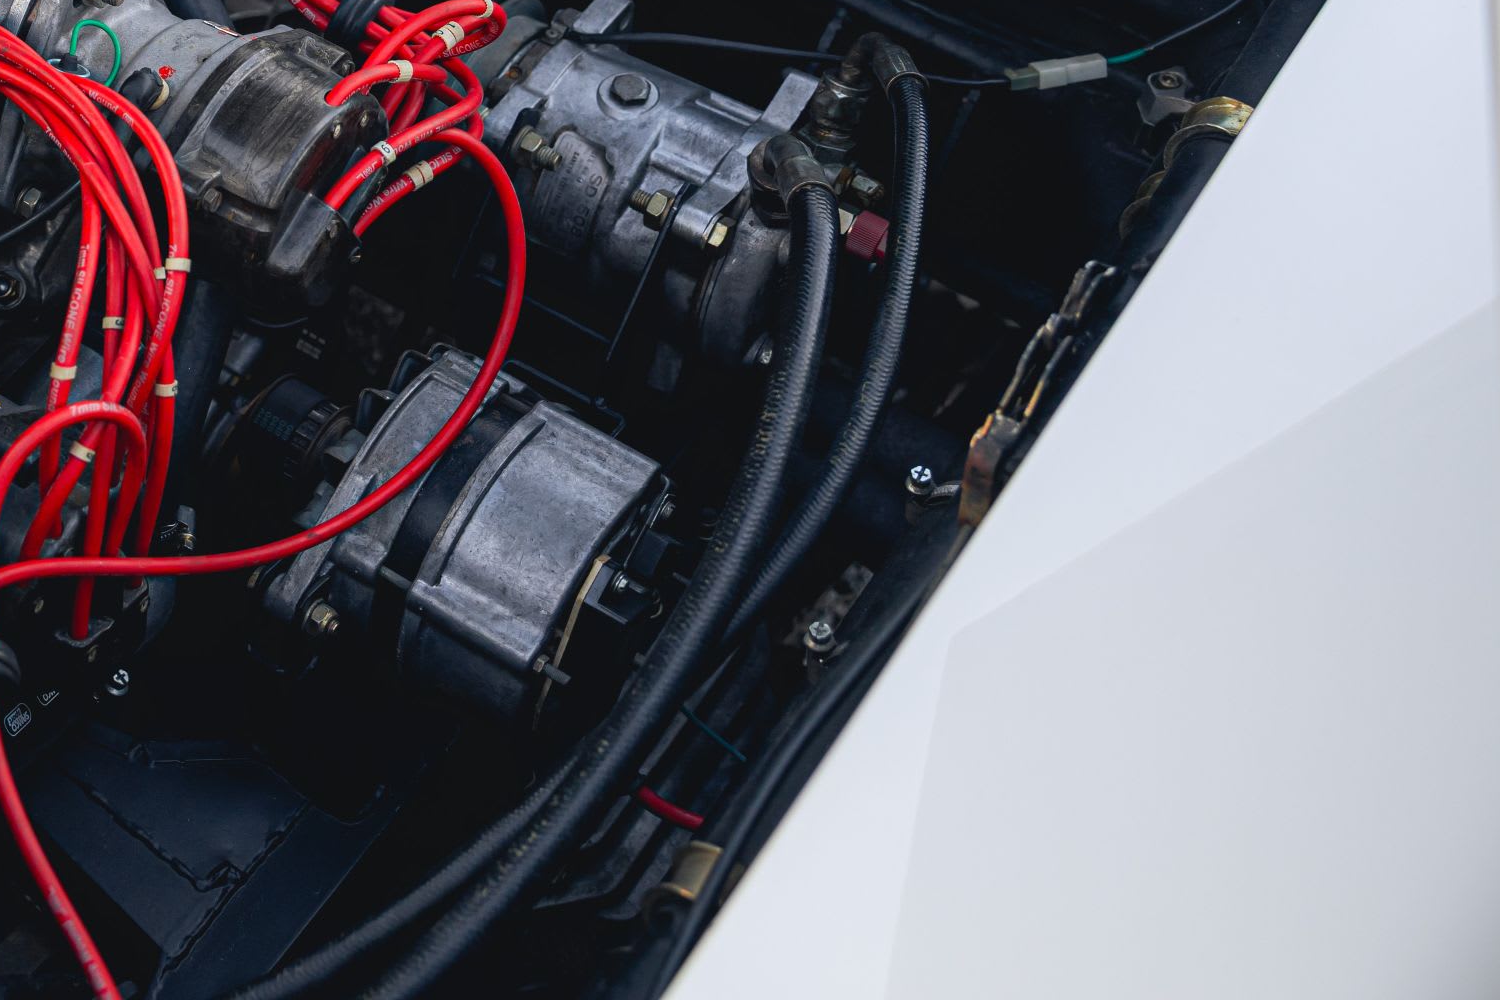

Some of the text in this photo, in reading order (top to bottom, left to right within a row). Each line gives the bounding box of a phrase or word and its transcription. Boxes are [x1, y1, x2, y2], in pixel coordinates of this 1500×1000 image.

[443, 39, 482, 59] SILICONE
[88, 89, 120, 112] Wound
[383, 178, 408, 196] Wire
[65, 270, 87, 330] SILICONE
[154, 278, 175, 341] SILICONE
[57, 332, 74, 364] Wire
[126, 371, 149, 409] Wound
[68, 402, 100, 417] 7mm
[11, 710, 30, 732] SAMCO
